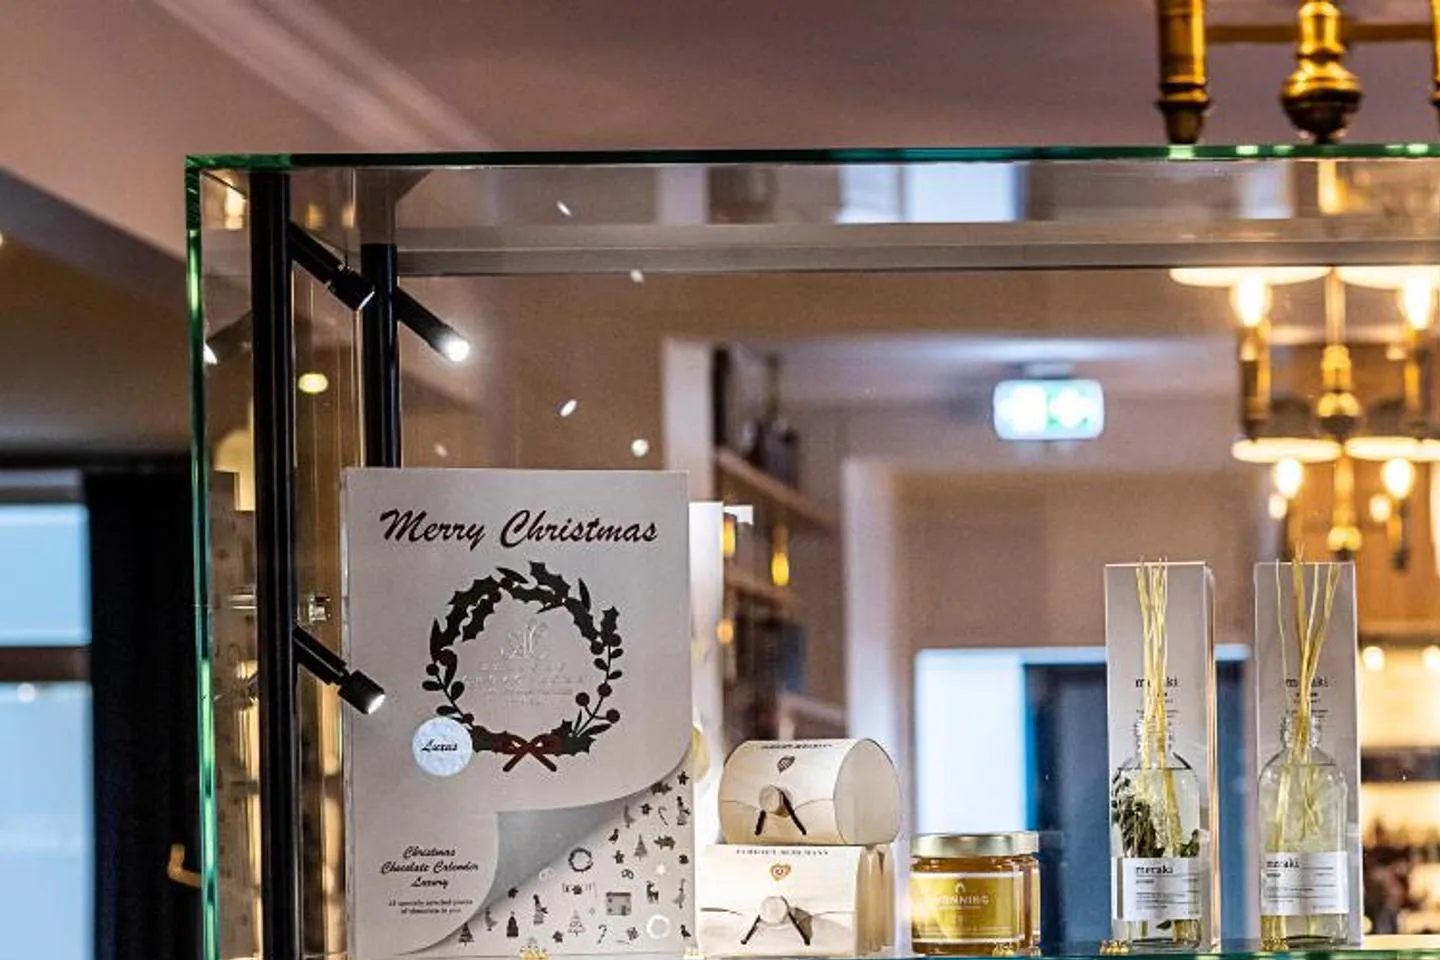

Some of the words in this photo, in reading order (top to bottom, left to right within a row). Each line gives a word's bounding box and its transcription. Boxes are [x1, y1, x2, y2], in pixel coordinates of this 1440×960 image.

[379, 508, 485, 551] Merry
[500, 509, 658, 548] Christmas
[402, 845, 456, 859] Christmas
[379, 860, 430, 875] Chocolate
[410, 876, 449, 890] Luxury
